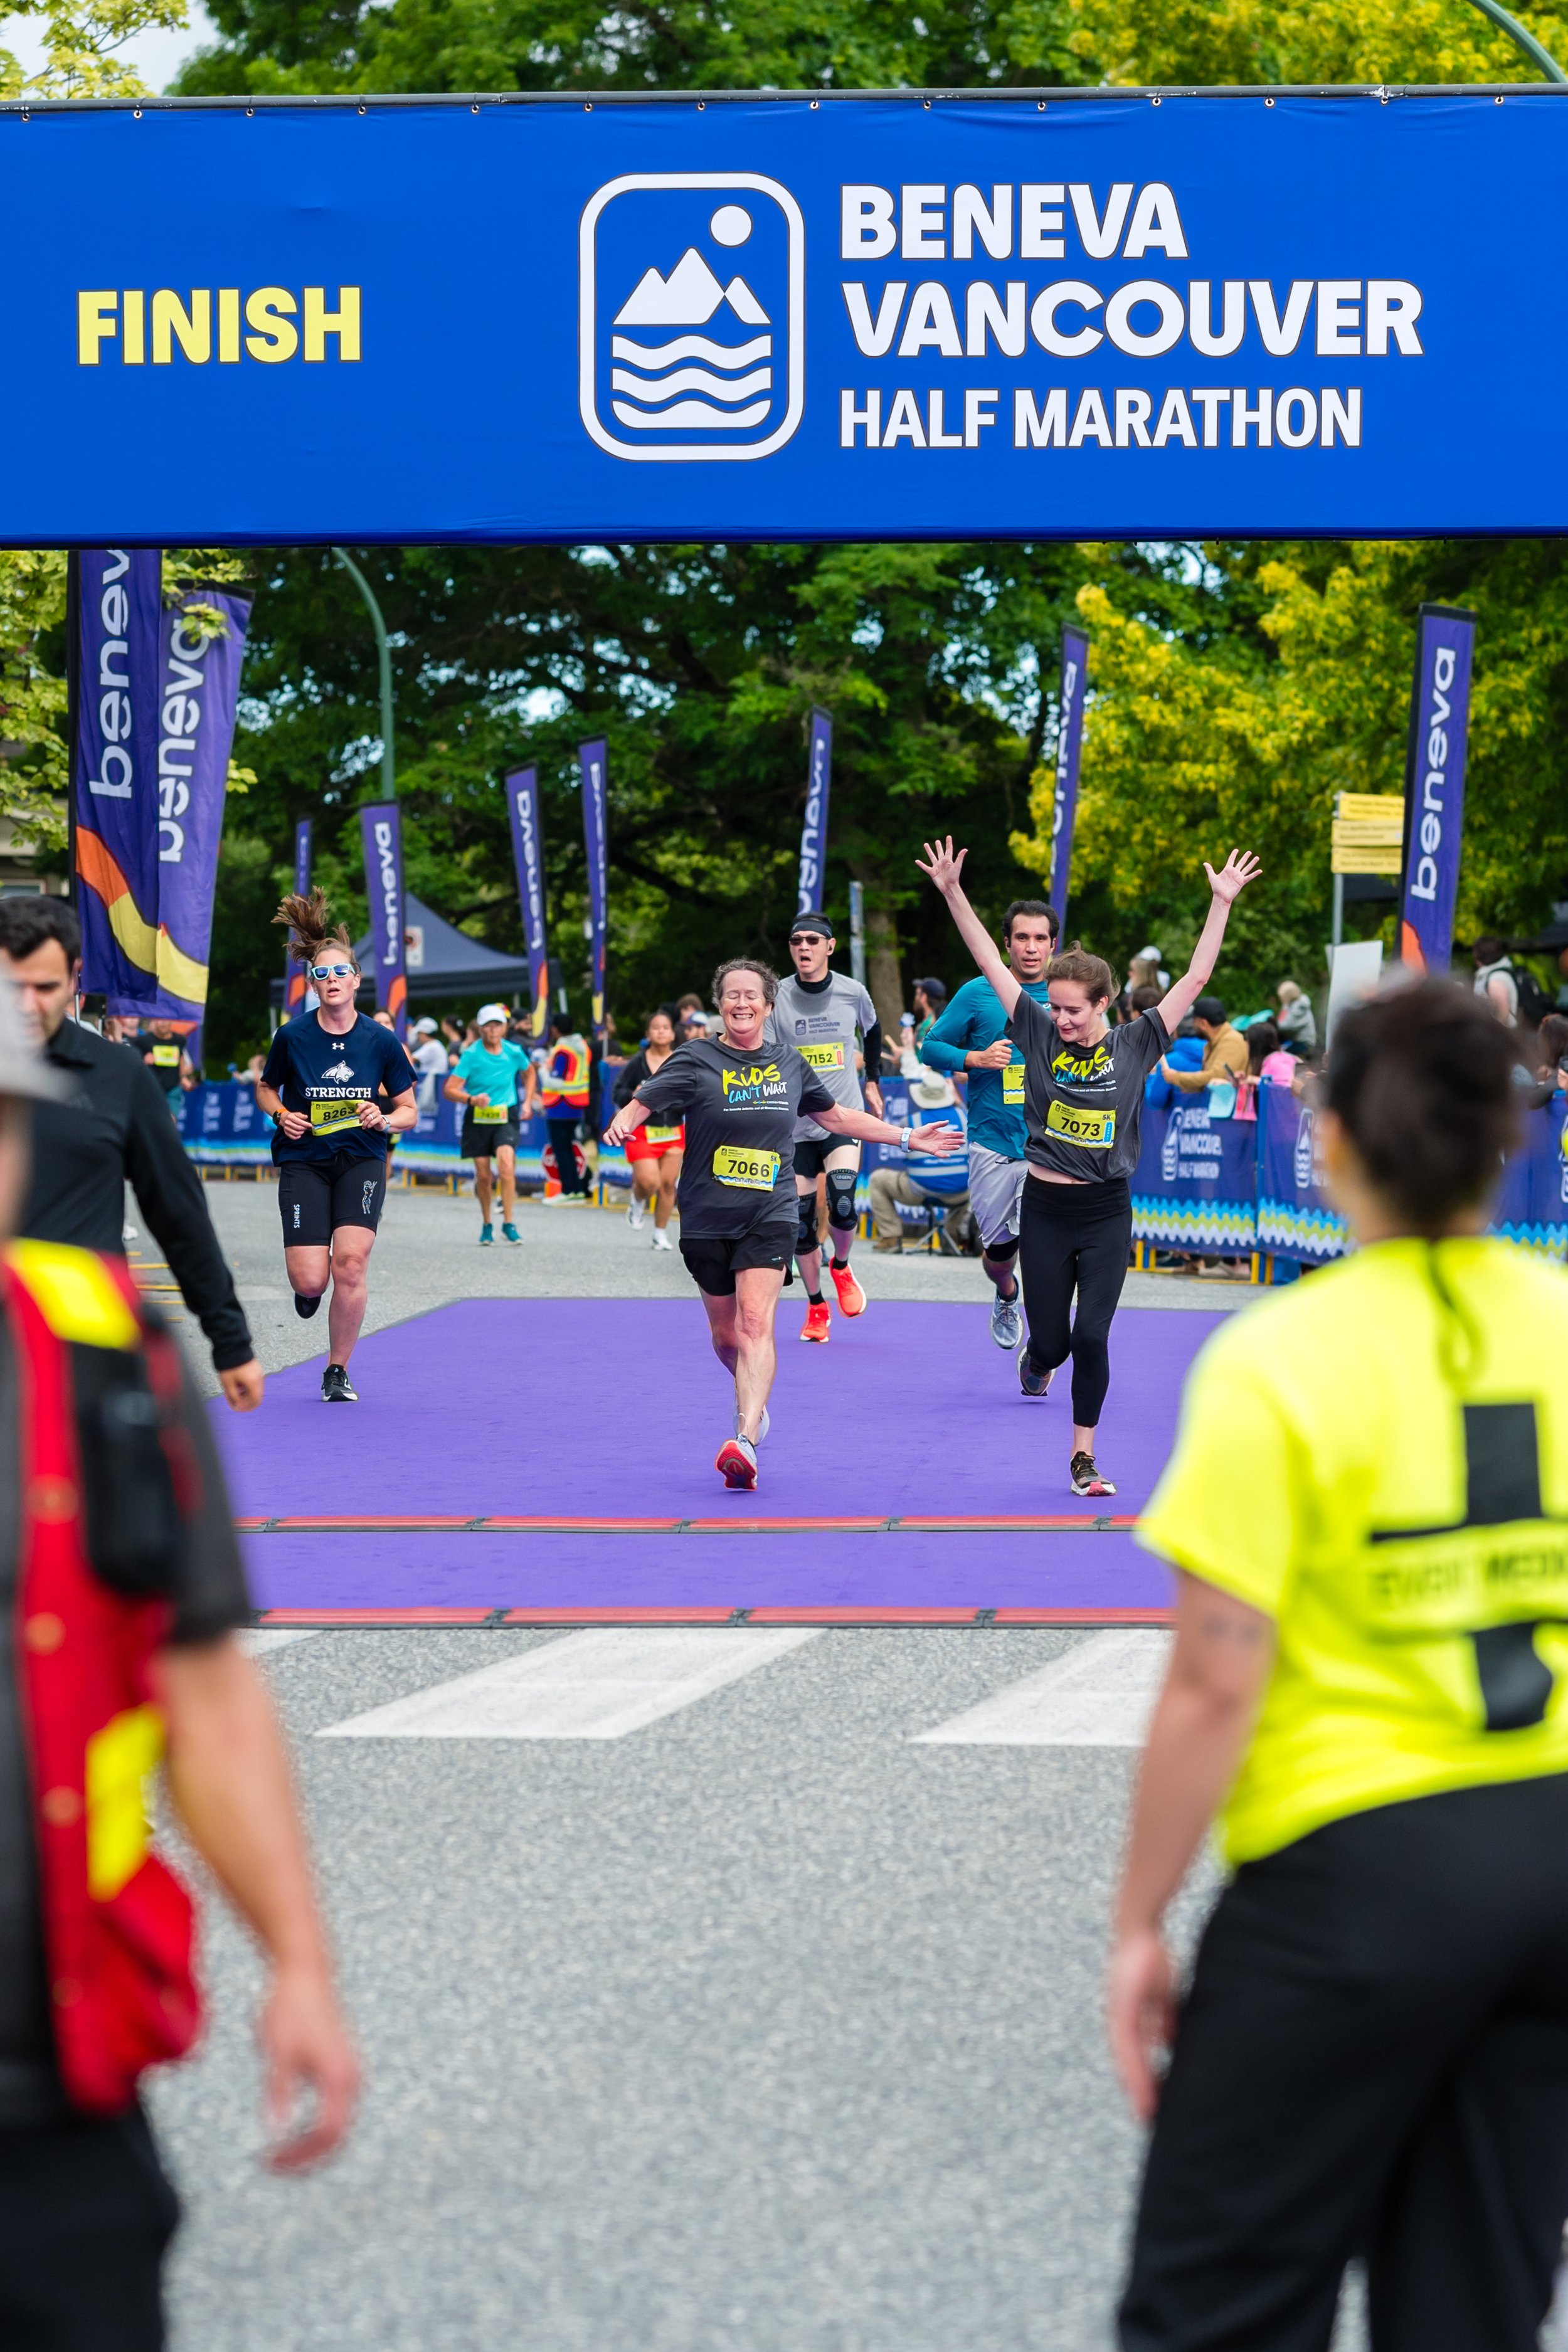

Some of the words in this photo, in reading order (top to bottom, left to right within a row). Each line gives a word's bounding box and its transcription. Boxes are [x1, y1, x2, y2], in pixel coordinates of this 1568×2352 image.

[842, 184, 1187, 258] BENEVA
[79, 288, 359, 364] FINISH
[843, 281, 1422, 356] VANCOUVER
[842, 390, 998, 447] HALF
[1015, 389, 1360, 447] MARATHON
[89, 549, 132, 798] benev
[1411, 647, 1456, 901] beneva
[807, 1053, 833, 1064] 7152
[305, 1087, 371, 1098] STRENGTH
[729, 1086, 761, 1104] CAN'T
[322, 1106, 355, 1121] 8263
[1061, 1116, 1100, 1136] 7073
[728, 1160, 770, 1177] 7066
